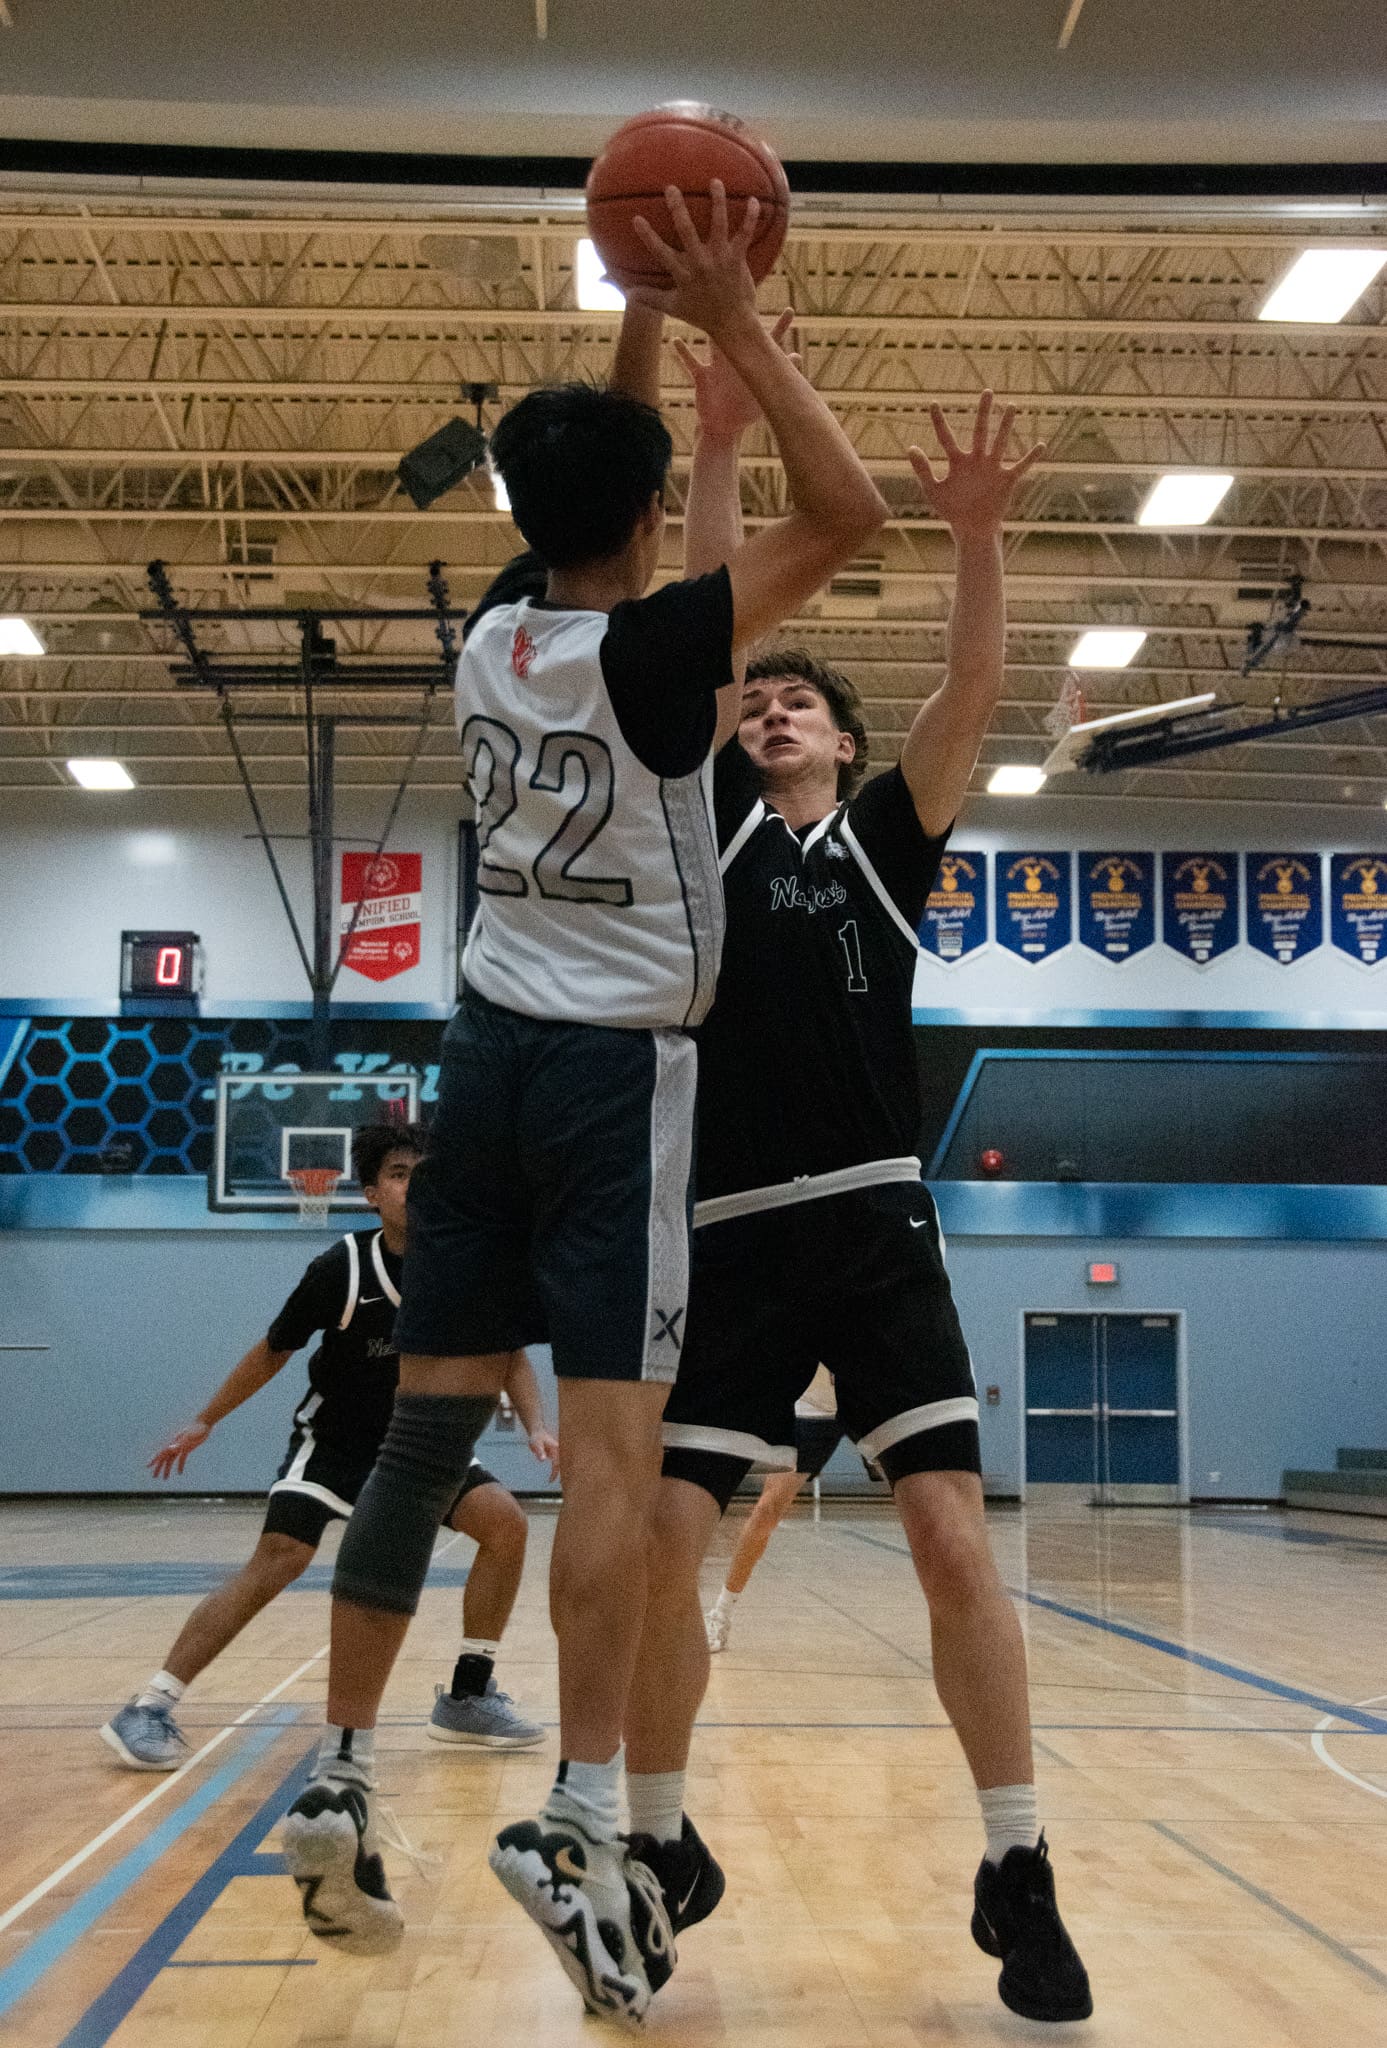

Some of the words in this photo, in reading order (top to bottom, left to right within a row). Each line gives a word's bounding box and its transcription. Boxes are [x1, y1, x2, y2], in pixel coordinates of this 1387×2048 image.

[461, 714, 633, 908] 22
[353, 898, 411, 917] NIFIED
[157, 947, 182, 985] 0
[838, 920, 868, 992] 1
